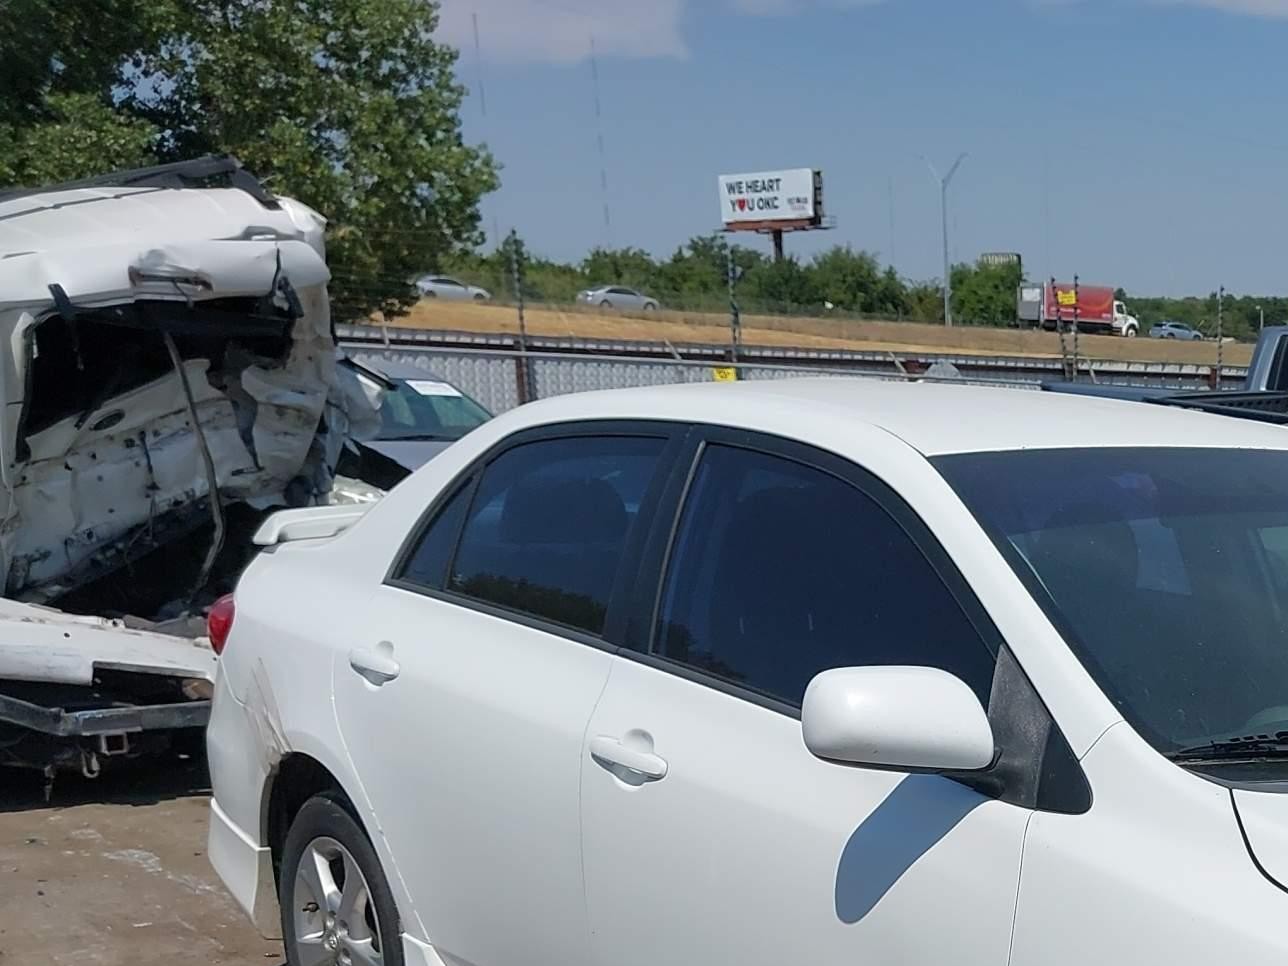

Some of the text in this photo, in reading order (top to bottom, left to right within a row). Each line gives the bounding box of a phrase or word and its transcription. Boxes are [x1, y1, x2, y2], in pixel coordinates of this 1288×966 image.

[725, 178, 782, 195] WE HEART
[757, 196, 780, 210] OKC
